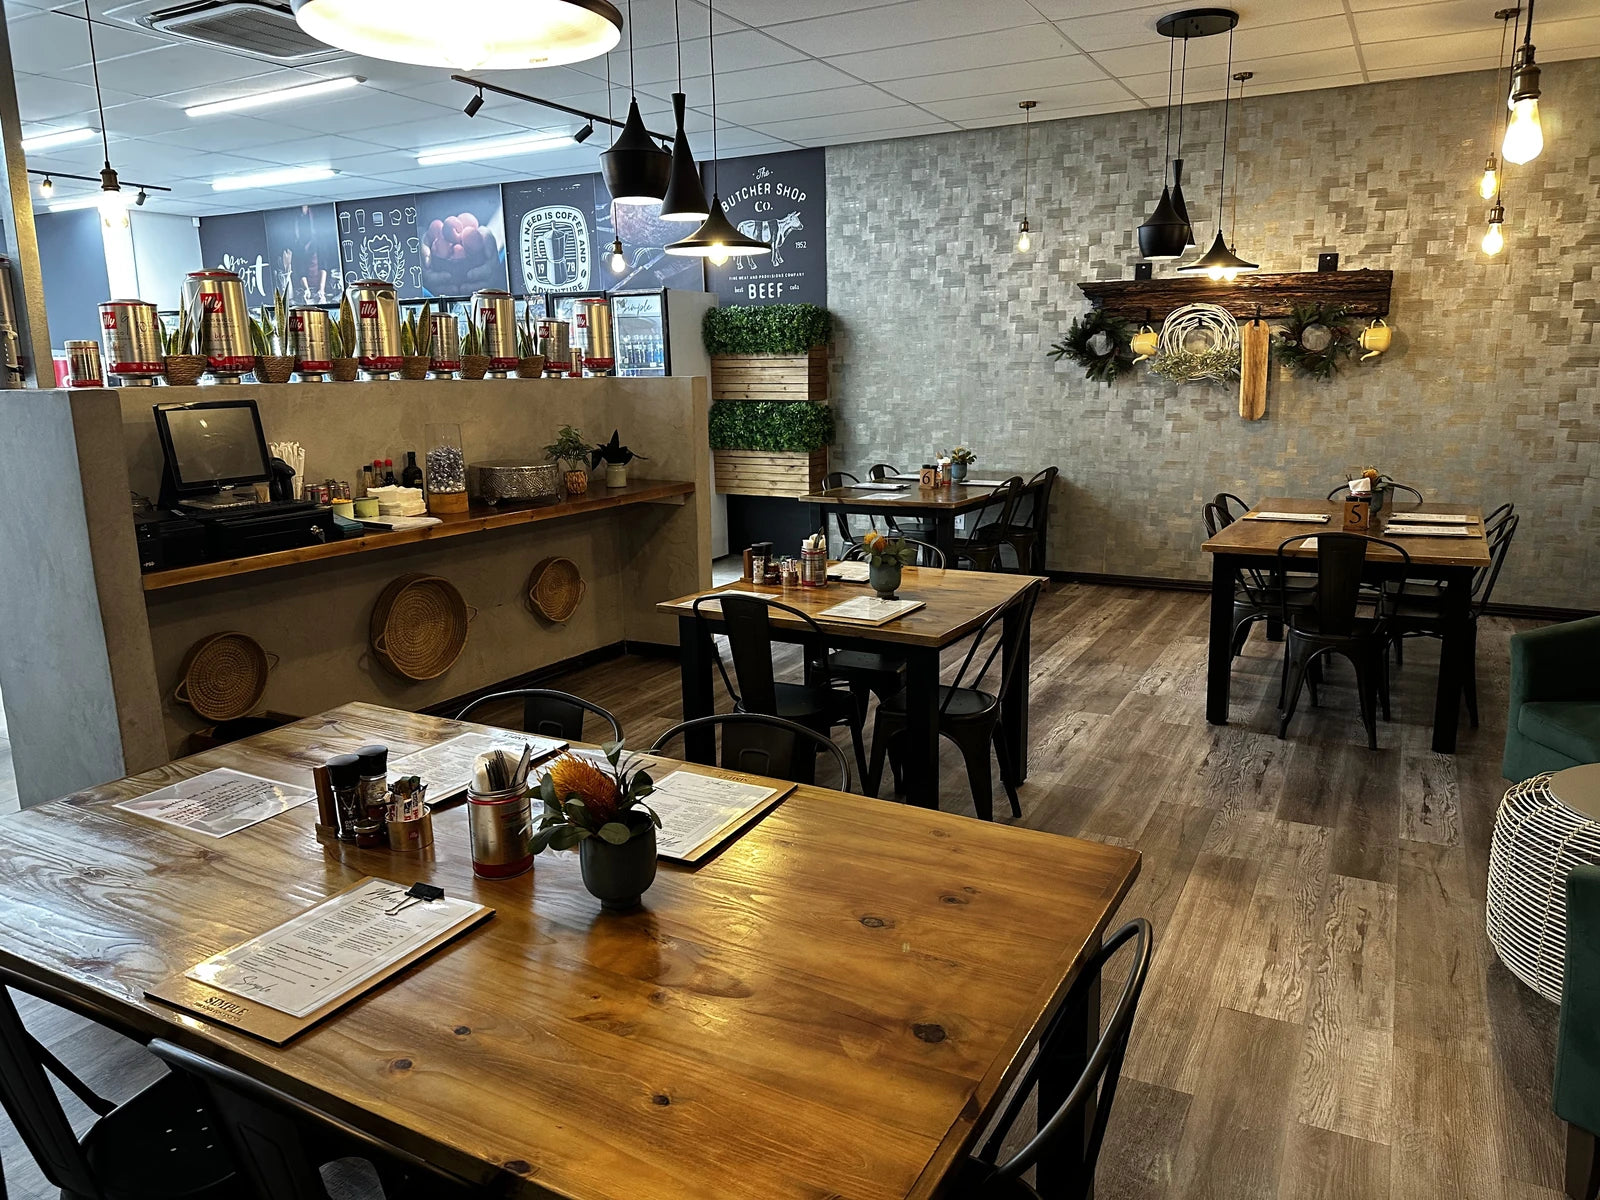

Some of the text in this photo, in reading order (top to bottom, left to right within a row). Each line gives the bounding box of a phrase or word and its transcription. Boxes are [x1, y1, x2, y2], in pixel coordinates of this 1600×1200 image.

[720, 182, 807, 213] BUTCHER SHOP
[524, 213, 542, 235] NEED
[544, 211, 553, 220] IS
[555, 211, 584, 236] COFFEE
[578, 240, 586, 263] AND
[795, 241, 807, 249] 1952
[524, 246, 532, 266] ALL
[537, 261, 576, 274] 19 78
[748, 282, 783, 299] BEEF
[204, 295, 222, 312] illy
[361, 303, 377, 317] illy
[103, 313, 116, 328] illy
[482, 310, 496, 321] illy
[922, 471, 931, 486] 6
[1349, 504, 1362, 524] 5
[365, 887, 400, 904] Menu
[204, 996, 250, 1017] SIMPLE
